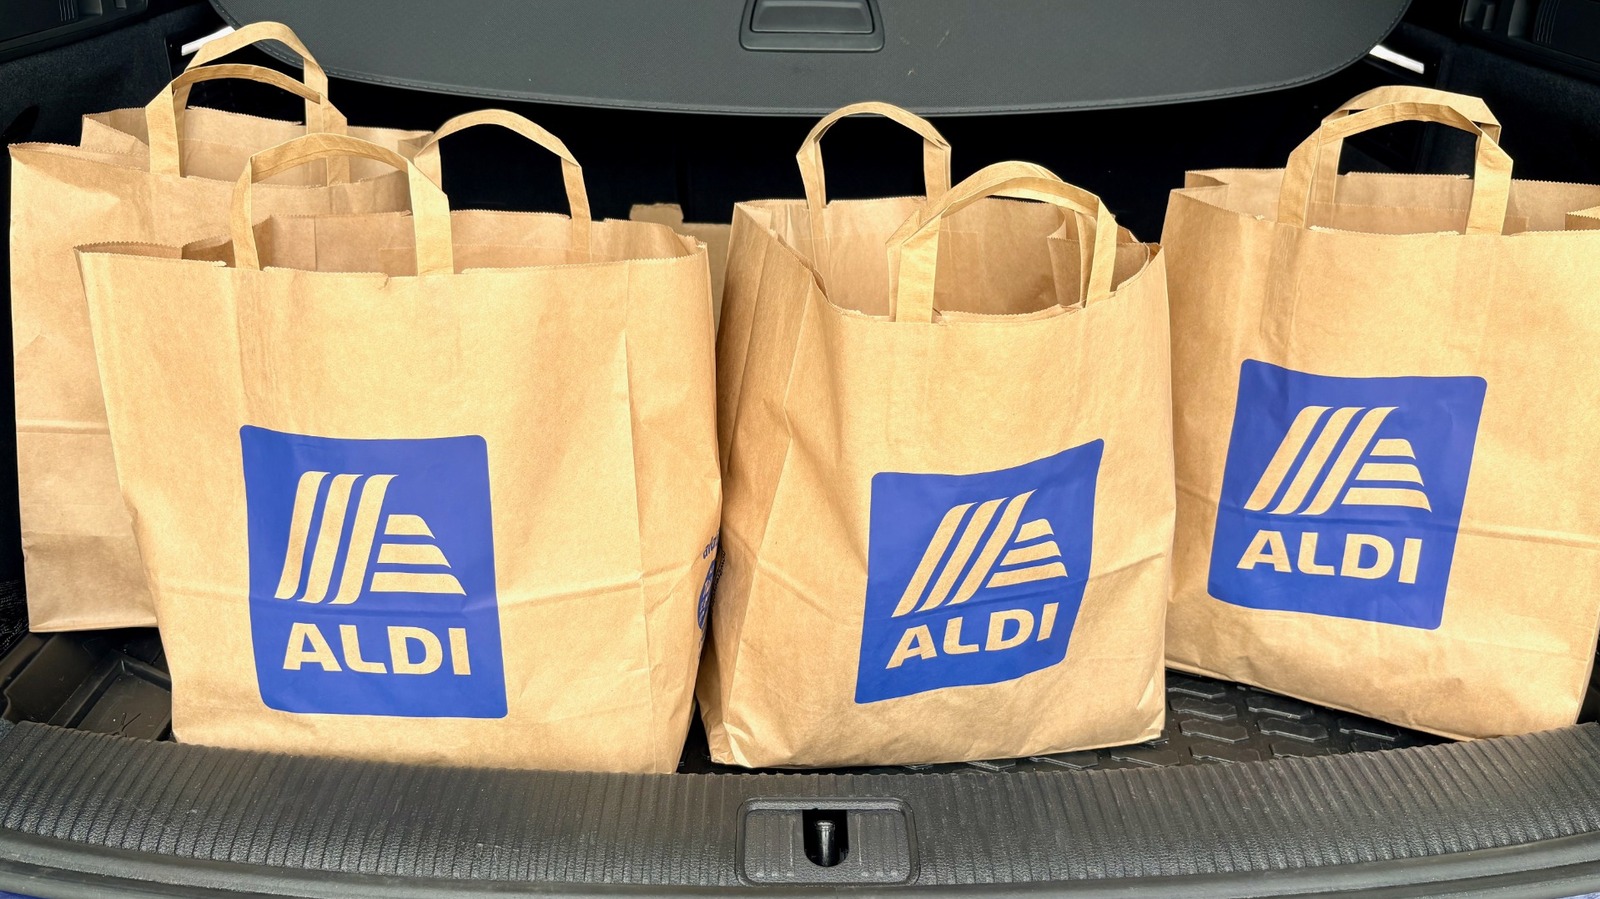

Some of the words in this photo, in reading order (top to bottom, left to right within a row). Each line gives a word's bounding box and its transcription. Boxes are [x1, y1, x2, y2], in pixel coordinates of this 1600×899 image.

[1238, 530, 1423, 583] ALDI
[283, 623, 471, 675] ALDI
[886, 603, 1059, 668] ALDI
